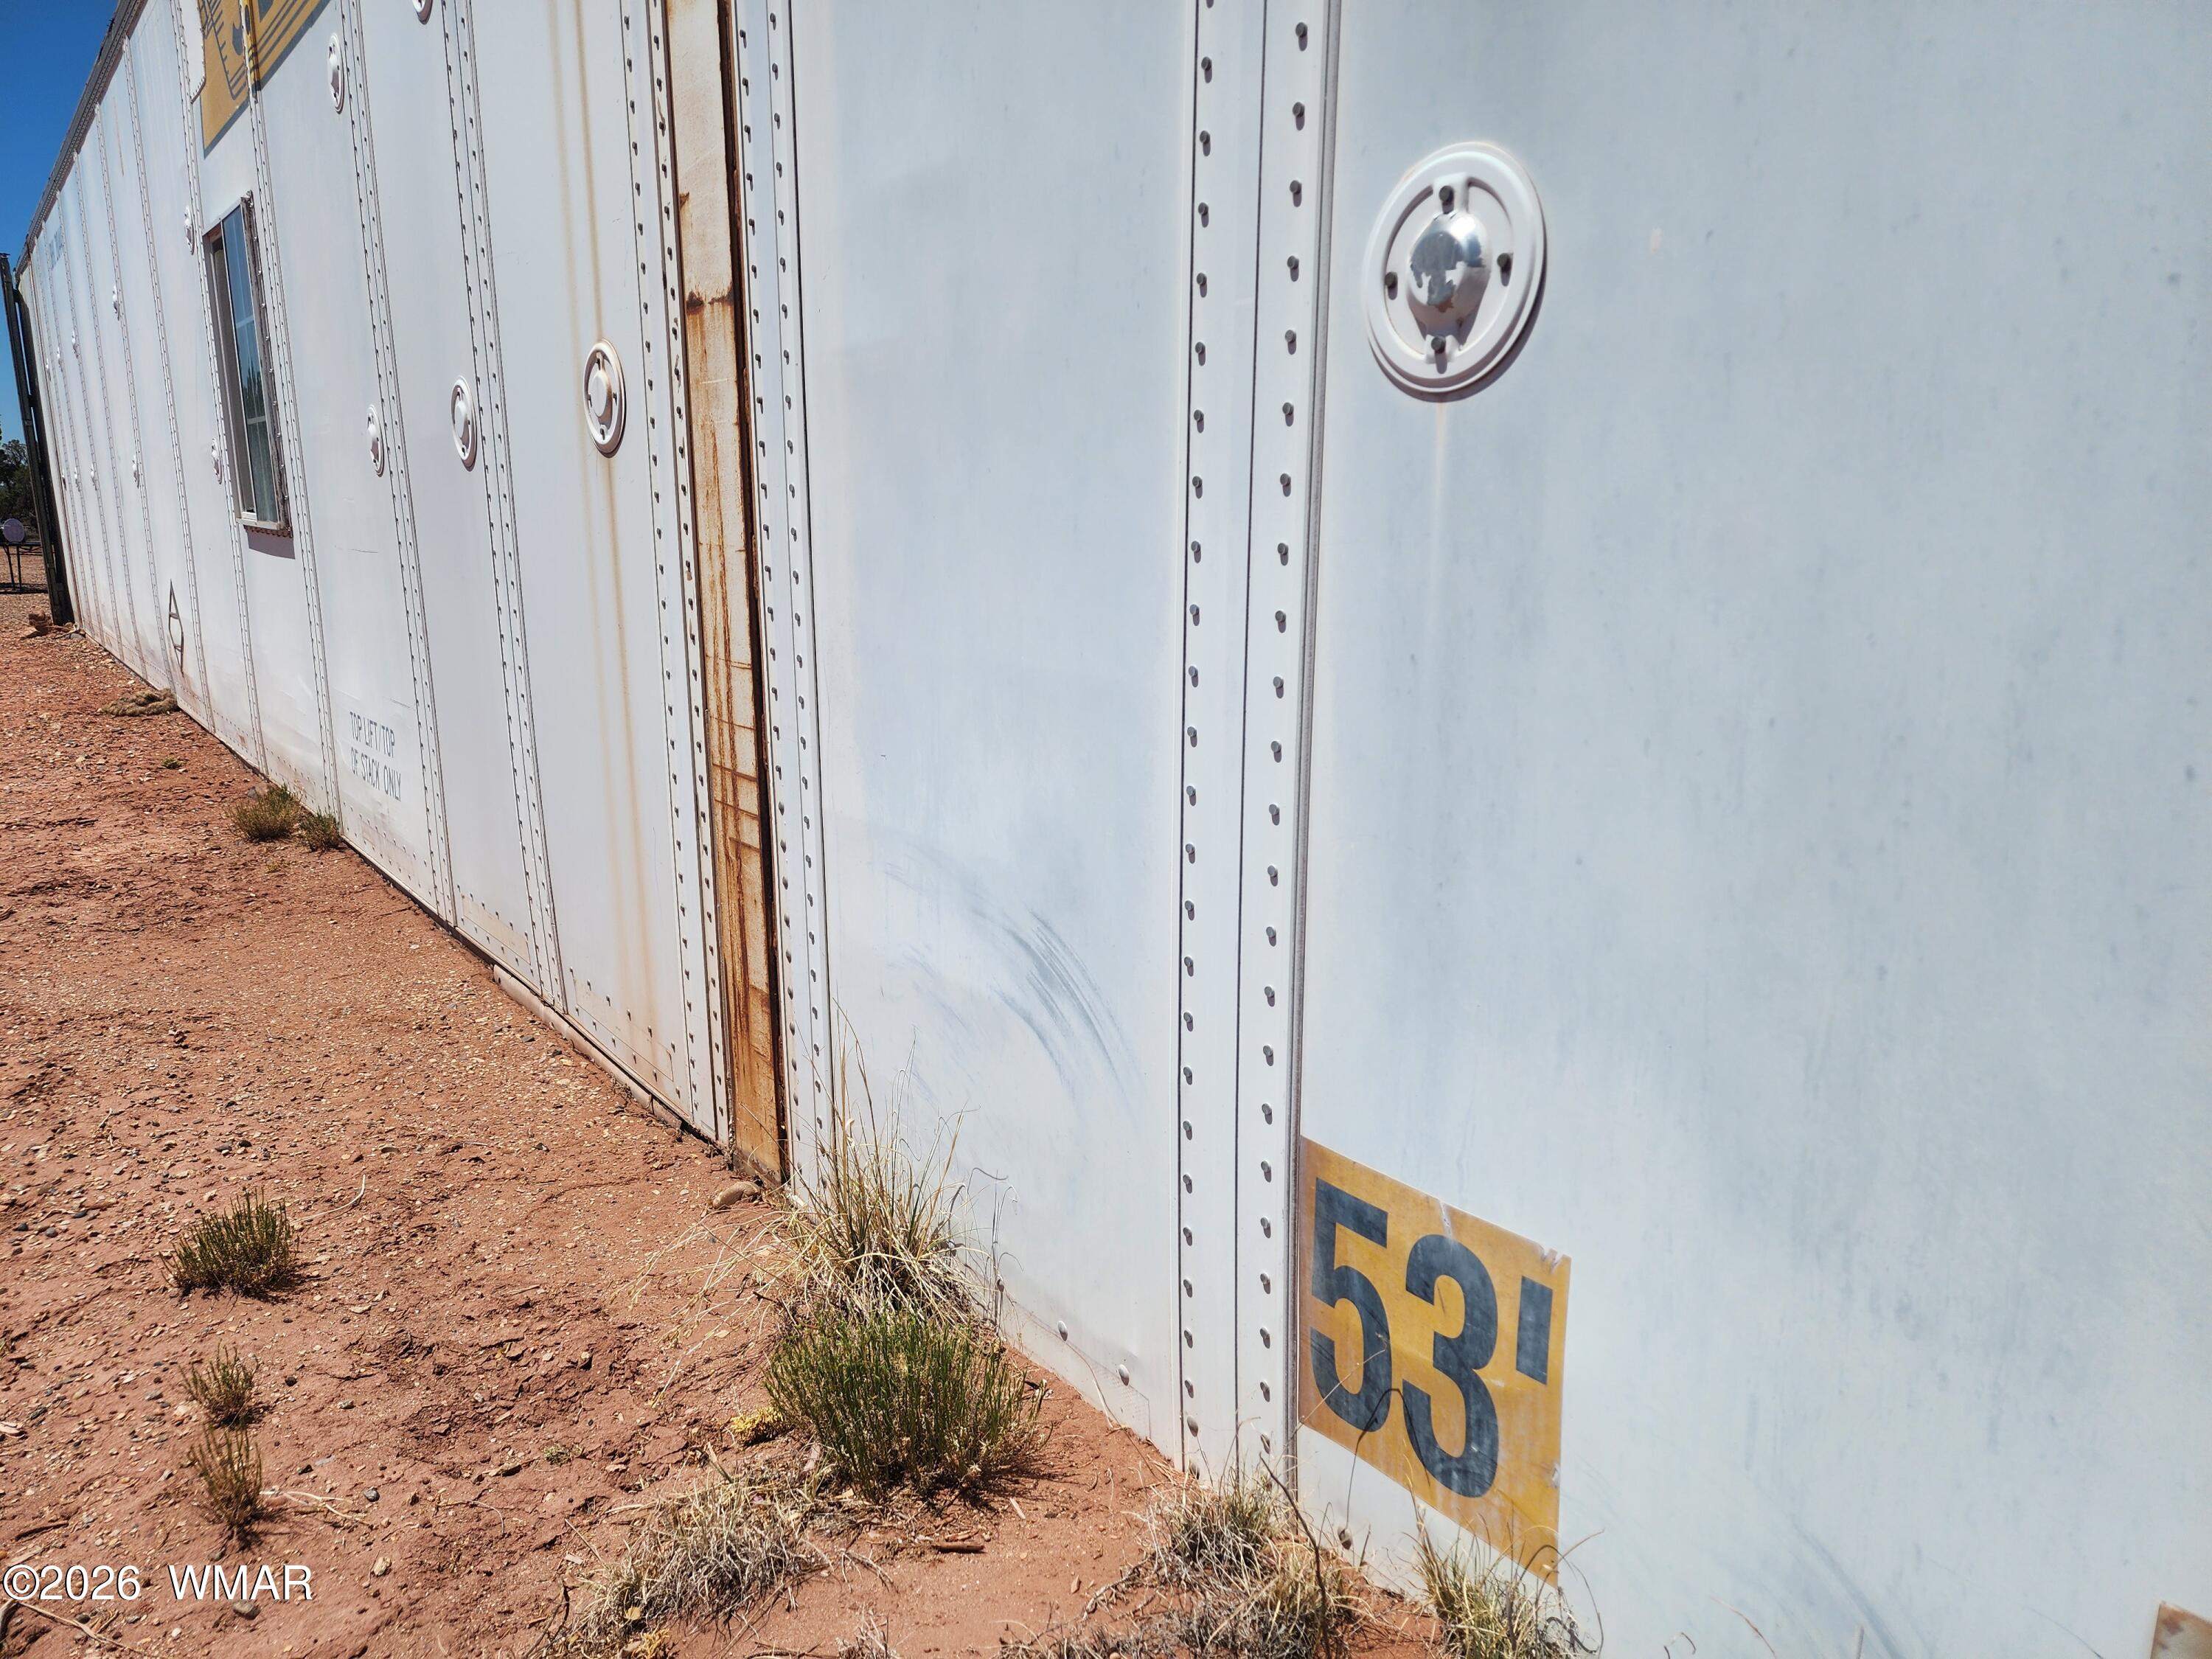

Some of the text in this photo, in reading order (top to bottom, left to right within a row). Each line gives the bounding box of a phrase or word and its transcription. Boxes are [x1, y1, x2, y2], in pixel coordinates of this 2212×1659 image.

[350, 711, 362, 742] TOP
[351, 746, 401, 802] OF STACK ONLY
